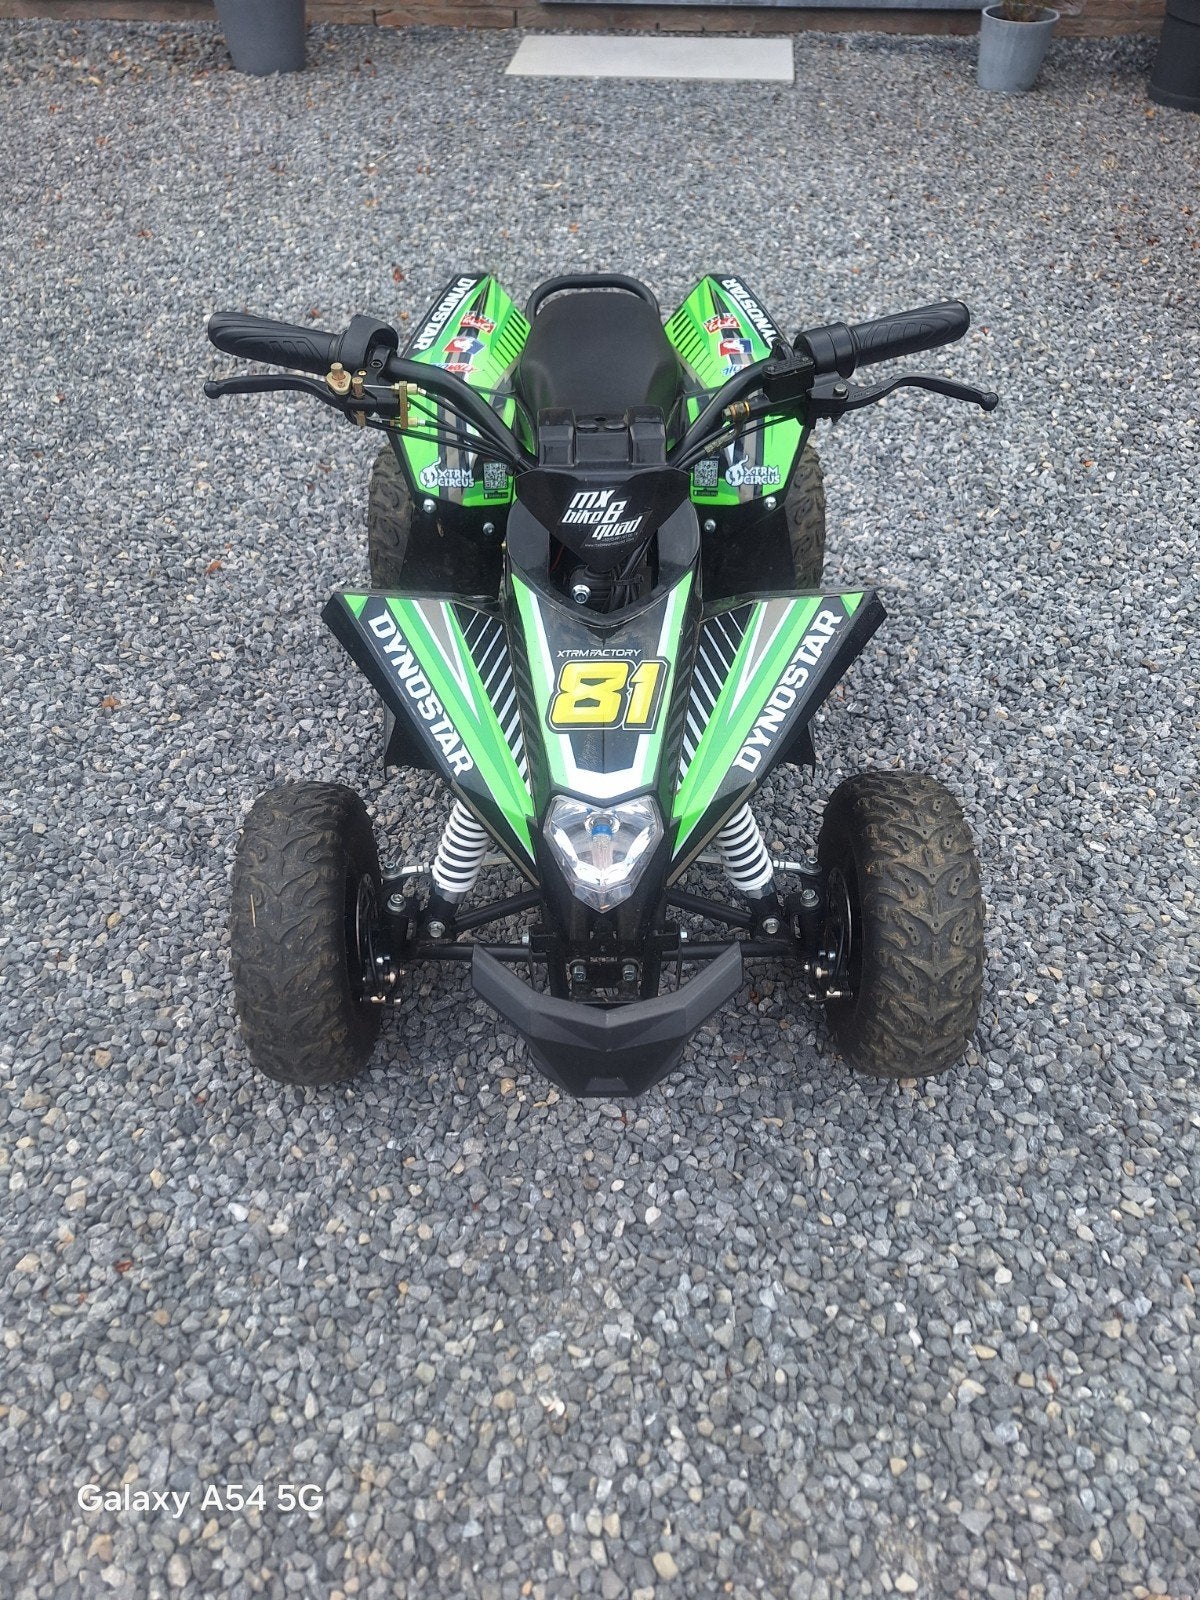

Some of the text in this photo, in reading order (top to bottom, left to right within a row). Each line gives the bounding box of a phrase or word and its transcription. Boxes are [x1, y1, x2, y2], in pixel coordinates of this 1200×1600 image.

[413, 278, 477, 350] DYNOSTAR
[438, 478, 475, 487] CIRCUS
[744, 475, 780, 485] CIRCUS
[562, 509, 604, 524] bike
[592, 516, 643, 540] quad
[368, 609, 474, 776] DYNOSTAR
[550, 660, 667, 729] 81
[732, 609, 843, 773] DYNOSTAR
